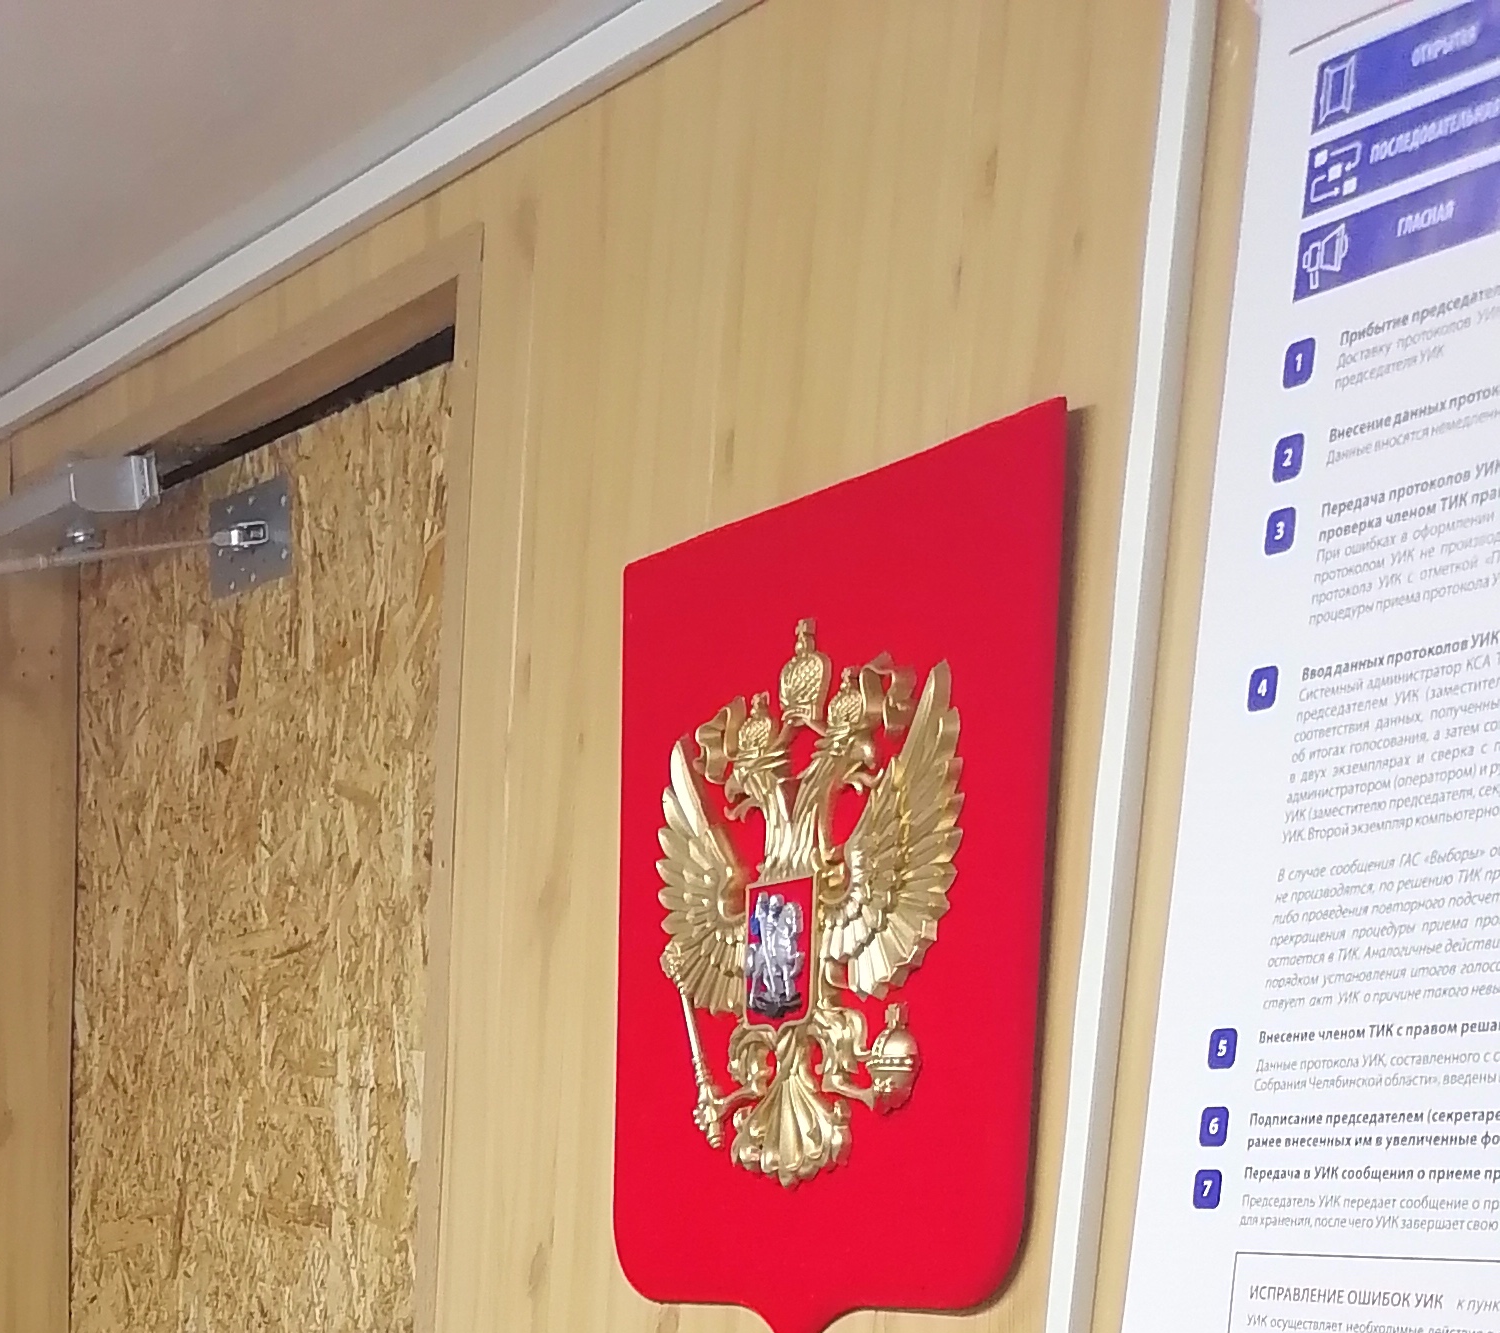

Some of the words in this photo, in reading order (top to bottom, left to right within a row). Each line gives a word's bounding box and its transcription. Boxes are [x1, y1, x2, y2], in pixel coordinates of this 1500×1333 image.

[1396, 200, 1455, 237] ГЛАСНАЯ
[1340, 318, 1409, 346] Прибытие
[1296, 354, 1302, 372] 1
[1336, 342, 1392, 370] Доставку
[1329, 415, 1391, 443] Внесение
[1393, 400, 1446, 426] данных
[1282, 449, 1292, 467] 2
[1321, 491, 1385, 517] Передача
[1389, 470, 1471, 503] протоколов
[1319, 516, 1382, 543] проверка
[1386, 504, 1436, 525] членом
[1441, 492, 1467, 511] ТИК
[1274, 522, 1284, 540] 3
[1317, 547, 1340, 563] При
[1345, 535, 1395, 556] ошибках
[1314, 558, 1385, 584] протоколом
[1391, 550, 1414, 567] УИК
[1420, 546, 1435, 558] не
[1378, 572, 1401, 590] УИК
[1302, 665, 1332, 681] Ввод
[1334, 656, 1384, 677] данных
[1387, 639, 1468, 667] протоколов
[1471, 630, 1499, 649] УИК
[1258, 679, 1267, 696] 4
[1299, 680, 1363, 701] Системный
[1367, 662, 1461, 690] администратор
[1467, 655, 1491, 670] КСА
[1297, 696, 1387, 724] председателем
[1395, 690, 1419, 707] УИК
[1294, 721, 1369, 742] соответствия
[1309, 744, 1345, 760] итогах
[1445, 724, 1479, 739] затем
[1431, 745, 1474, 763] сверка
[1307, 822, 1349, 841] Второй
[1330, 858, 1395, 877] сообщения
[1399, 852, 1420, 866] ГАС
[1396, 874, 1453, 893] решению
[1458, 868, 1481, 883] ТИК
[1422, 917, 1468, 934] приема
[1410, 964, 1456, 978] итогов
[1338, 991, 1360, 1005] УИК
[1423, 986, 1468, 999] такого
[1259, 1031, 1314, 1044] Внесение
[1319, 1029, 1366, 1041] членом
[1370, 1024, 1393, 1038] ТИК
[1397, 1026, 1403, 1036] с
[1406, 1024, 1457, 1040] правом
[1217, 1040, 1227, 1056] 5
[1256, 1059, 1297, 1072] Данные
[1300, 1056, 1359, 1071] протокола
[1390, 1051, 1480, 1067] составленного
[1254, 1079, 1306, 1094] Собрания
[1309, 1076, 1382, 1088] Челябинской
[1443, 1072, 1496, 1085] введены
[1209, 1118, 1219, 1134] 6
[1250, 1113, 1322, 1126] Подписание
[1326, 1111, 1423, 1126] председателем
[1248, 1137, 1281, 1150] ранее
[1284, 1135, 1350, 1146] внесенных
[1355, 1136, 1371, 1146] им
[1385, 1134, 1477, 1150] увеличенные
[1244, 1167, 1300, 1182] Передача
[1314, 1166, 1339, 1180] УИК
[1342, 1166, 1413, 1181] сообщения
[1417, 1168, 1424, 1180] о
[1428, 1168, 1480, 1182] приеме
[1202, 1180, 1212, 1196] 7
[1242, 1194, 1315, 1210] Председатель
[1319, 1195, 1340, 1208] УИК
[1343, 1197, 1396, 1210] передает
[1400, 1196, 1468, 1210] сообщение
[1314, 1217, 1346, 1227] после
[1348, 1218, 1373, 1229] чего
[1375, 1216, 1398, 1229] УИК
[1400, 1219, 1465, 1231] завершает
[1466, 1220, 1499, 1232] свою
[1250, 1285, 1344, 1304] ИСПРАВЛЕНИЕ
[1348, 1291, 1410, 1307] ОШИБОК
[1414, 1294, 1444, 1309] УИК
[1248, 1314, 1267, 1327] УИК
[1270, 1316, 1343, 1332] осуществляет
